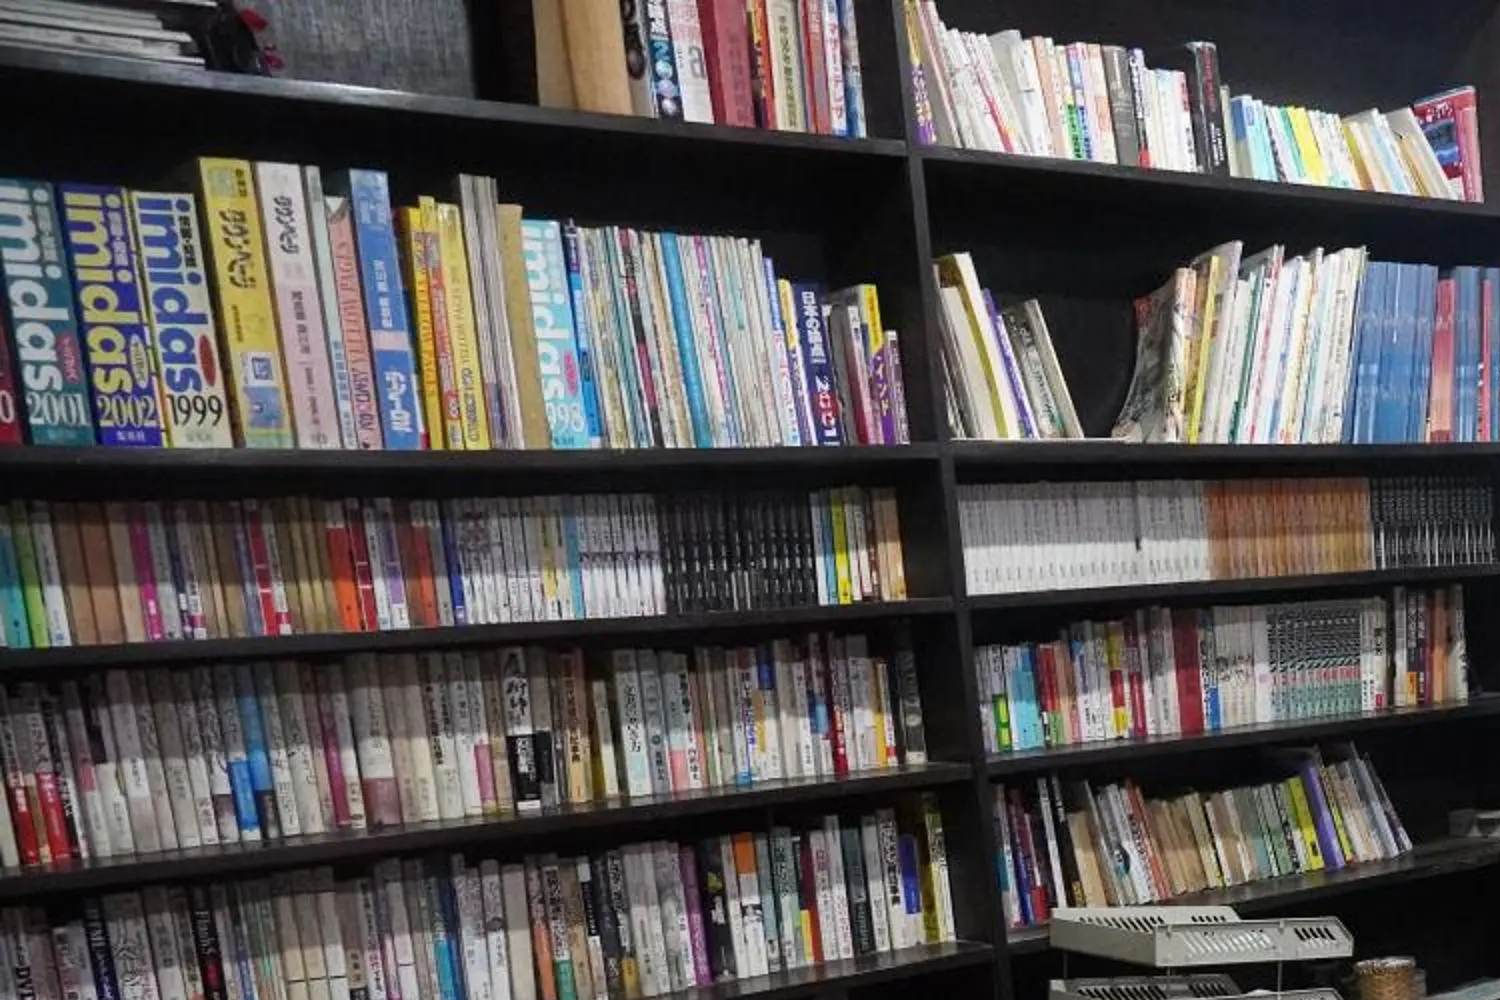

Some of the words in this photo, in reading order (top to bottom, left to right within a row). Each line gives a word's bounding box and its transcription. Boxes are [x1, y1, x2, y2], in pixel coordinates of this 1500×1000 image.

[0, 187, 70, 391] imidas
[63, 191, 140, 394] imidas
[136, 197, 209, 394] imidas
[521, 222, 571, 400] imidas
[26, 391, 92, 426] 2001
[96, 392, 158, 428] 2002
[168, 393, 224, 428] 1999
